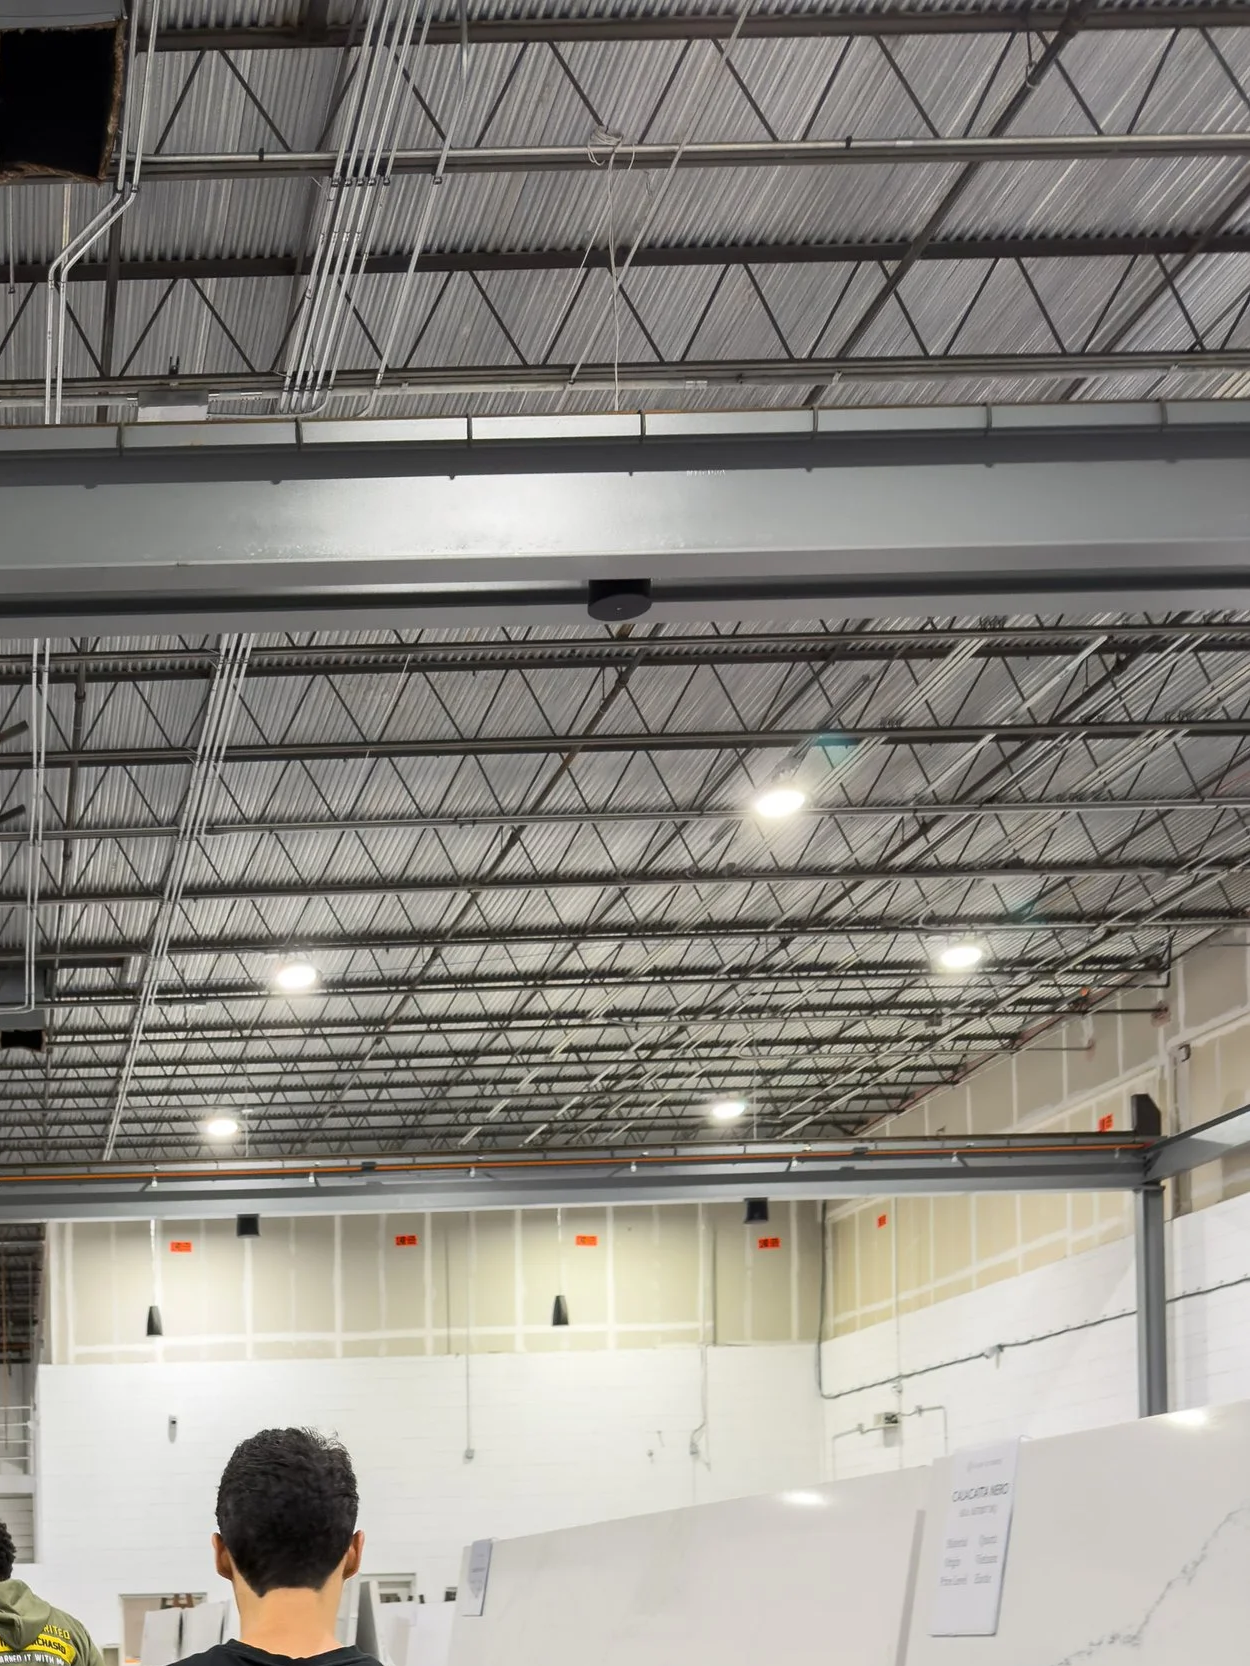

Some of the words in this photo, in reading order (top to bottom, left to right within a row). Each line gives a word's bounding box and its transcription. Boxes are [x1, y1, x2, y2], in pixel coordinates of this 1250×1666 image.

[43, 1624, 70, 1640] RITED
[32, 1637, 67, 1655] CHASED
[23, 1653, 32, 1662] IT
[34, 1653, 55, 1665] WITH
